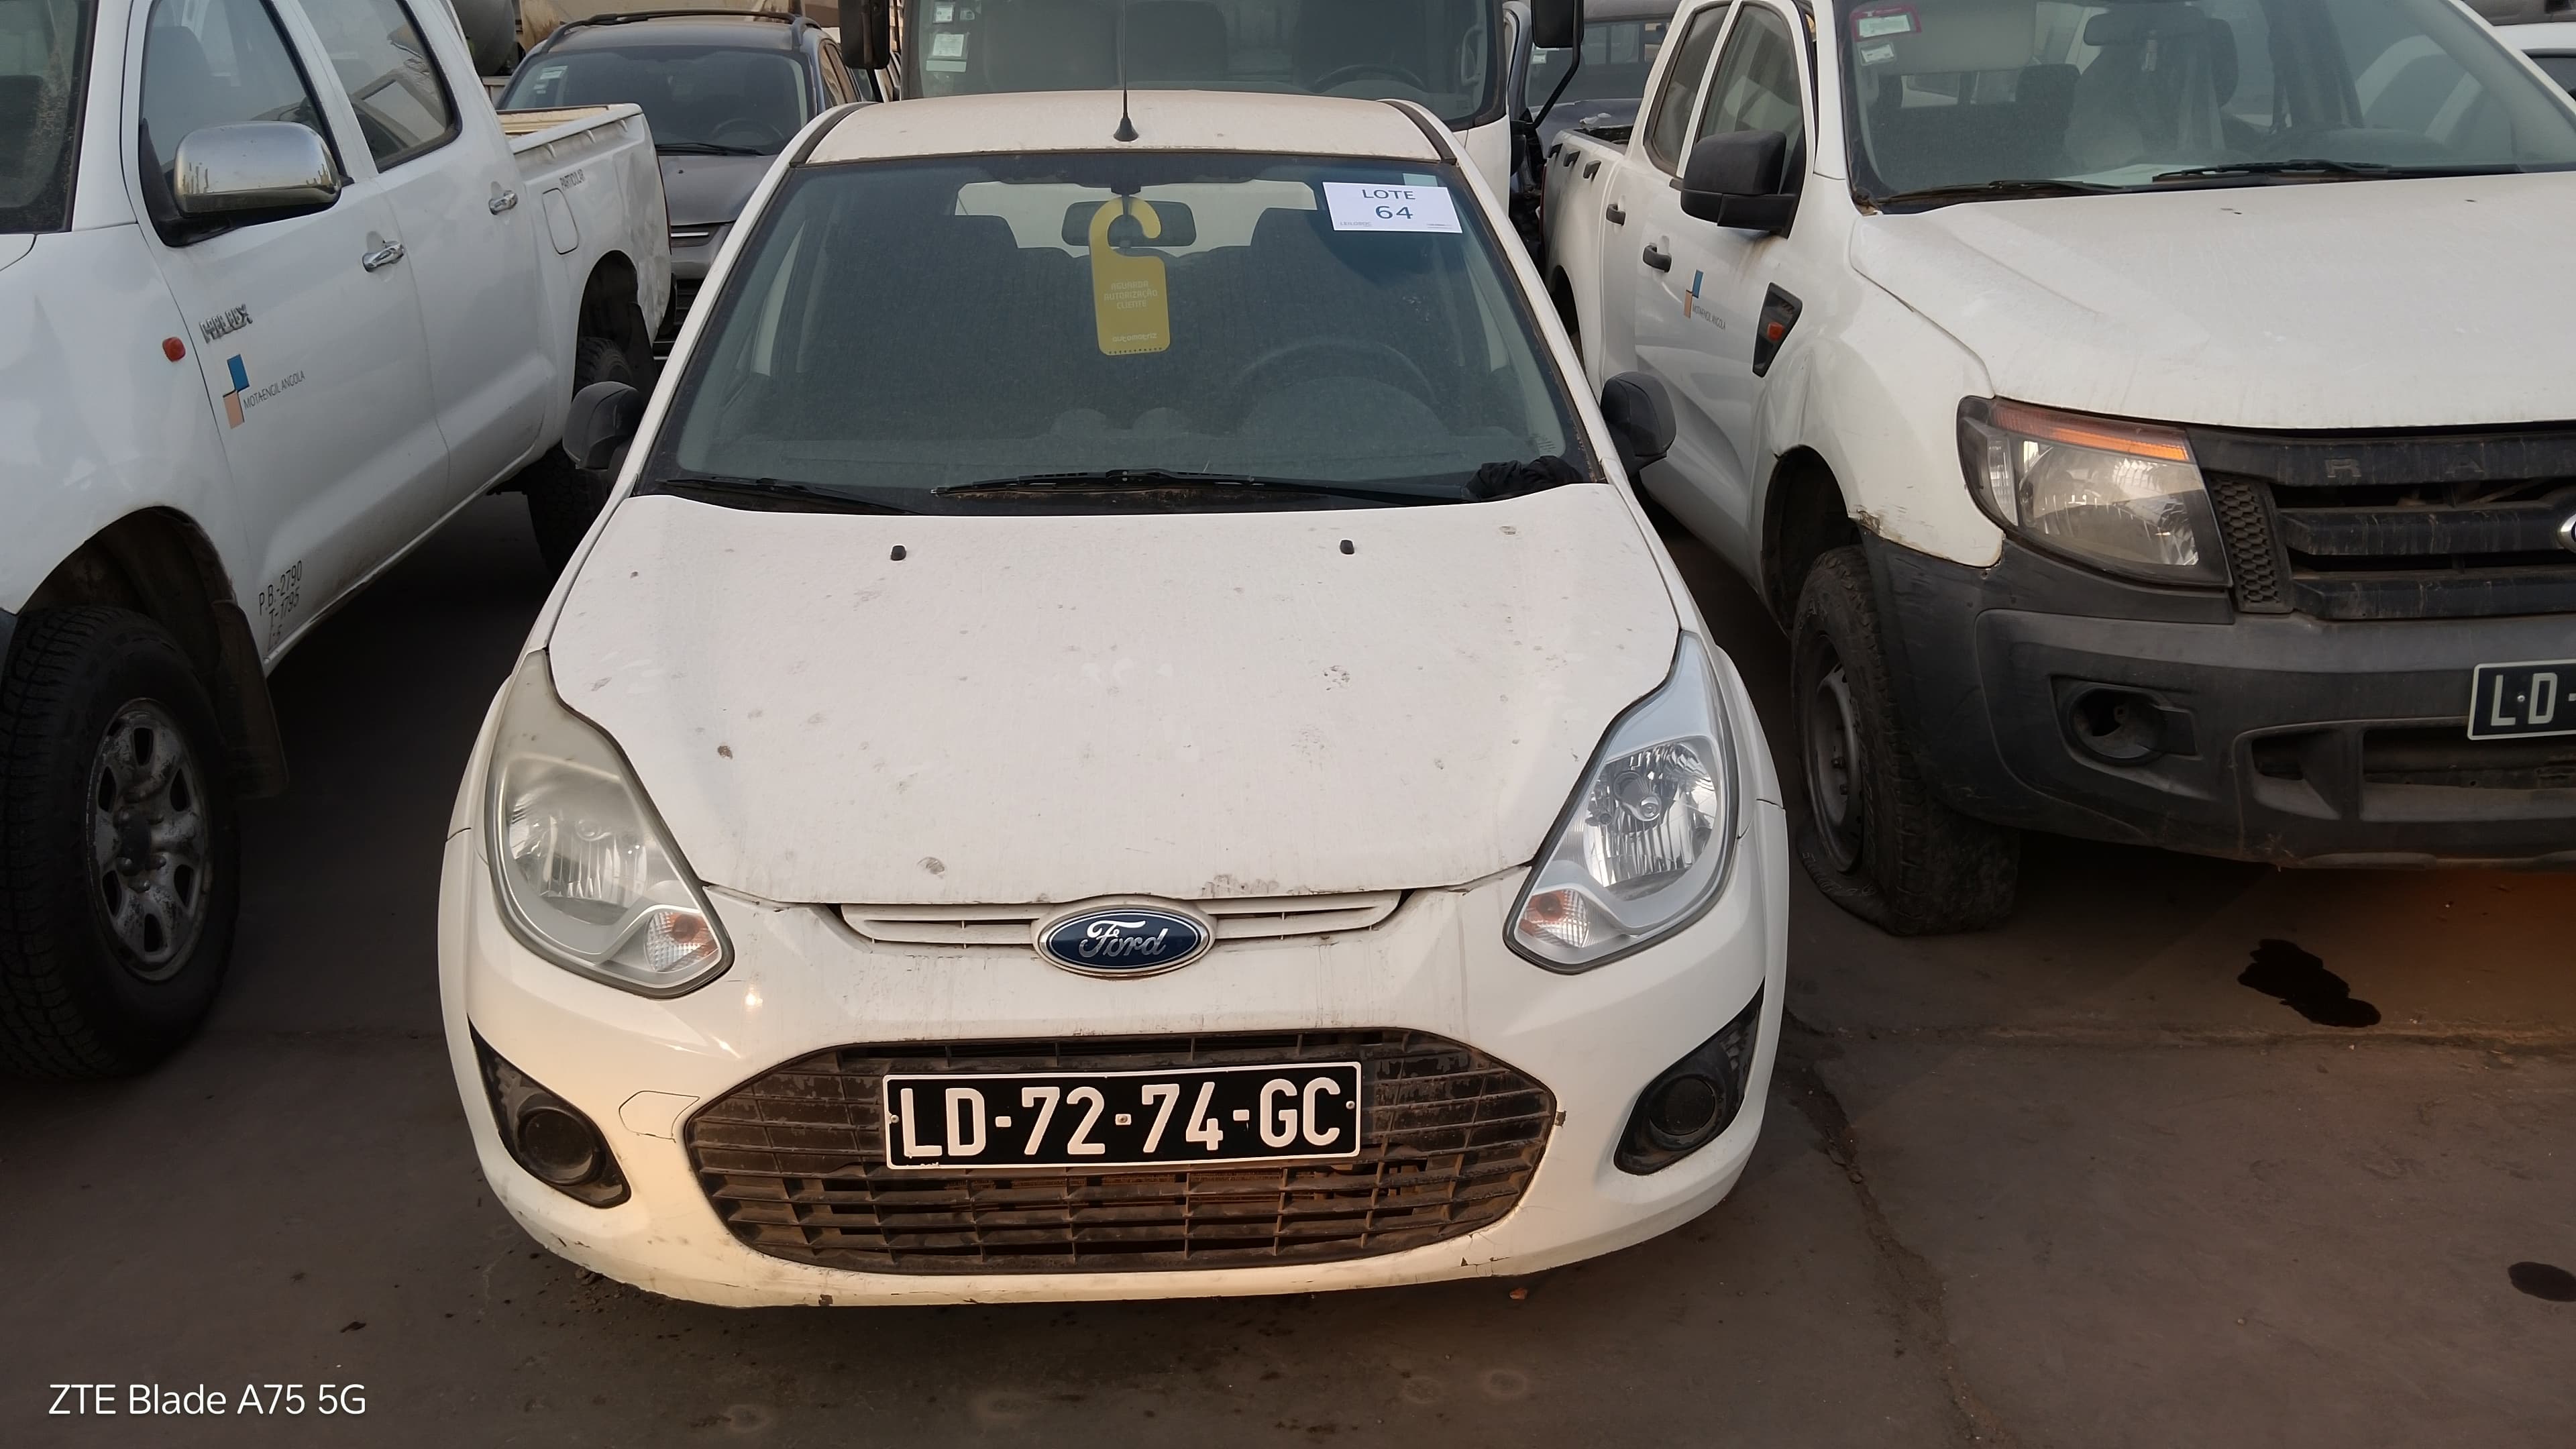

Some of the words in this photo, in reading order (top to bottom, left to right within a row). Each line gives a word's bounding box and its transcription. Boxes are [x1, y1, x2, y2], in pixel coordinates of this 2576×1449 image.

[1362, 189, 1415, 200] LOTE
[1375, 205, 1413, 219] 64
[199, 303, 253, 344] HILUX
[281, 370, 306, 391] ANGOLA
[1079, 920, 1169, 958] Ford
[900, 1077, 1340, 1157] LD-72-74-GC
